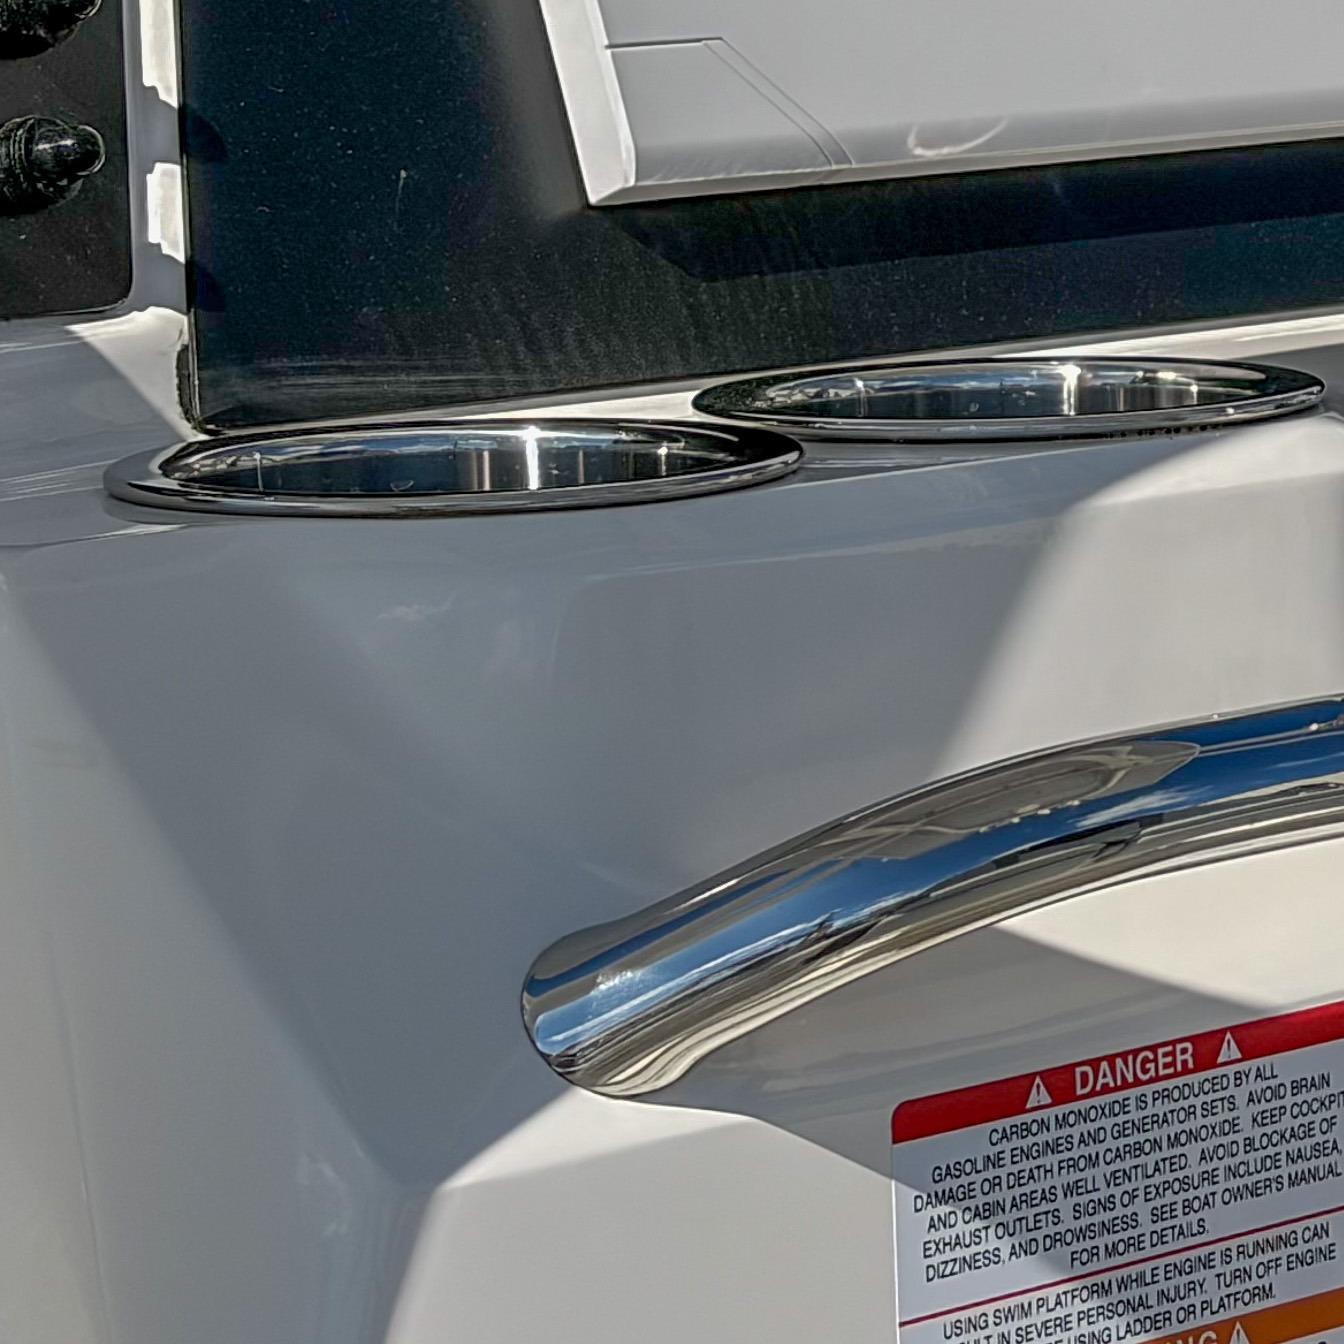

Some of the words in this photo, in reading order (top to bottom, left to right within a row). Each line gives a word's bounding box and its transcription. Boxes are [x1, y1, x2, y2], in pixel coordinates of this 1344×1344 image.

[989, 1118, 1050, 1146] CARBON
[1054, 1097, 1131, 1130] MONOXIDE
[1135, 1095, 1148, 1111] IS
[1152, 1073, 1230, 1106] PRODUCED
[1234, 1069, 1251, 1088] BY
[1254, 1061, 1278, 1083] ALL
[1074, 1042, 1194, 1096] DANGER
[914, 1183, 977, 1213] DAMAGE
[981, 1175, 1003, 1196] OR
[1007, 1163, 1053, 1190] DEATH
[1058, 1154, 1099, 1177] FROM
[1104, 1136, 1162, 1165] CARBON
[1167, 1117, 1243, 1149] MONOXIDE.
[1251, 1106, 1287, 1130] KEEP
[927, 1212, 958, 1233] AND
[962, 1199, 1006, 1225] CABIN
[1010, 1187, 1057, 1212] AREAS
[1061, 1175, 1100, 1199] WELL
[1103, 1153, 1191, 1189] VENTILATED.
[1199, 1142, 1239, 1165] AVOID
[1244, 1121, 1316, 1154] BLOCKAGE
[1320, 1115, 1338, 1135] OF
[932, 1150, 1007, 1183] GASOLINE
[1011, 1134, 1073, 1165] ENGINES
[1077, 1128, 1107, 1149] AND
[1111, 1105, 1197, 1139] GENERATOR
[1201, 1095, 1239, 1118] SETS.
[1247, 1084, 1287, 1106] AVOID
[1291, 1072, 1331, 1097] BRAIN
[923, 1225, 991, 1259] EXHAUST
[994, 1209, 1064, 1240] OUTLETS.
[1073, 1188, 1116, 1220] SIGNS
[1120, 1187, 1140, 1207] OF
[1144, 1168, 1220, 1202] EXPOSURE
[1224, 1152, 1282, 1180] INCLUDE
[1286, 1138, 1342, 1166] NAUSEA,
[926, 1247, 1005, 1283] DIZZINESS,
[1008, 1238, 1039, 1262] AND
[1043, 1212, 1142, 1252] DROWSINESS.
[1151, 1203, 1178, 1224] SEE
[1182, 1193, 1218, 1216] BOAT
[1221, 1173, 1284, 1205] OWNER'S
[1288, 1161, 1342, 1189] MANUAL
[1070, 1246, 1100, 1270] FOR
[1104, 1233, 1146, 1259] MORE
[1151, 1218, 1209, 1248] DETAILS.
[943, 1312, 989, 1340] USING
[993, 1300, 1032, 1327] SWIM
[1036, 1279, 1112, 1314] PLATFORM
[1116, 1264, 1159, 1294] WHILE
[1164, 1251, 1216, 1281] ENGINE
[1220, 1247, 1233, 1265] IS
[1237, 1230, 1298, 1261] RUNNING
[1302, 1221, 1330, 1243] CAN
[1015, 1313, 1073, 1344] SEVERE
[1077, 1295, 1154, 1328] PERSONAL
[1156, 1277, 1207, 1307] INJURY.
[1214, 1264, 1252, 1290] TURN
[1256, 1256, 1283, 1279] OFF
[1286, 1242, 1337, 1272] ENGINE
[1116, 1305, 1172, 1342] LADDER
[1176, 1304, 1198, 1325] OR
[1201, 1283, 1276, 1316] PLATFORM.
